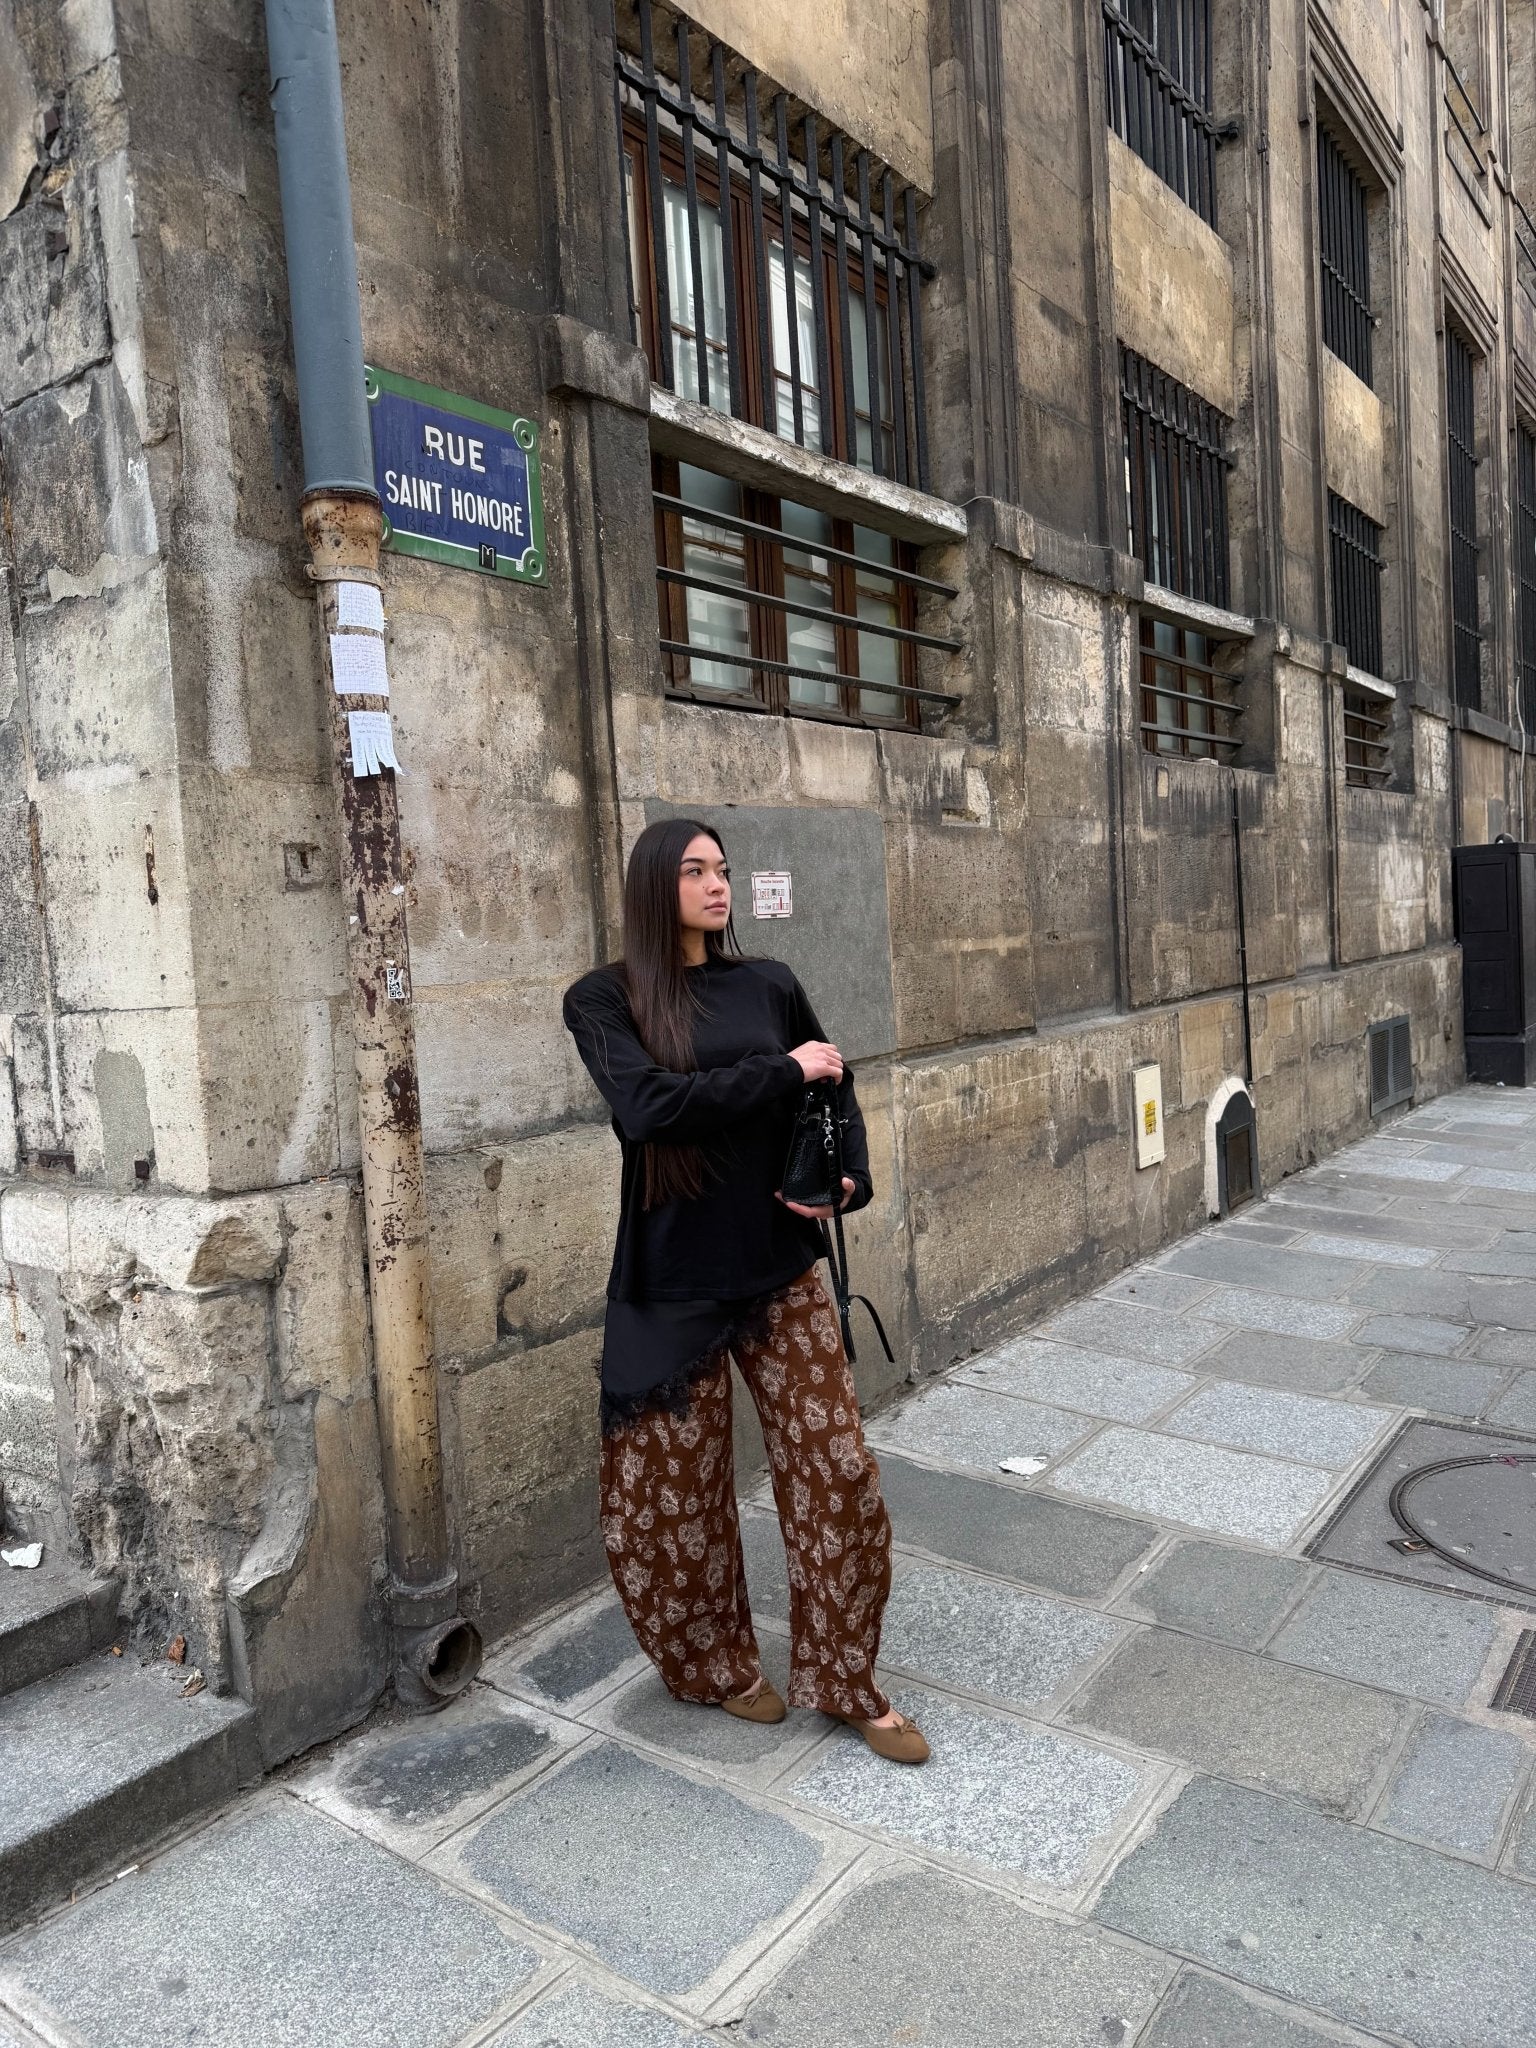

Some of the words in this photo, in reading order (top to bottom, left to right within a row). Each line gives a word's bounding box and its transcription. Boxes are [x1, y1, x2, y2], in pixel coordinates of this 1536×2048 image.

[424, 425, 486, 473] RUE
[384, 470, 443, 514] SAINT
[451, 487, 524, 537] HONORÉ
[405, 512, 449, 536] BIEN
